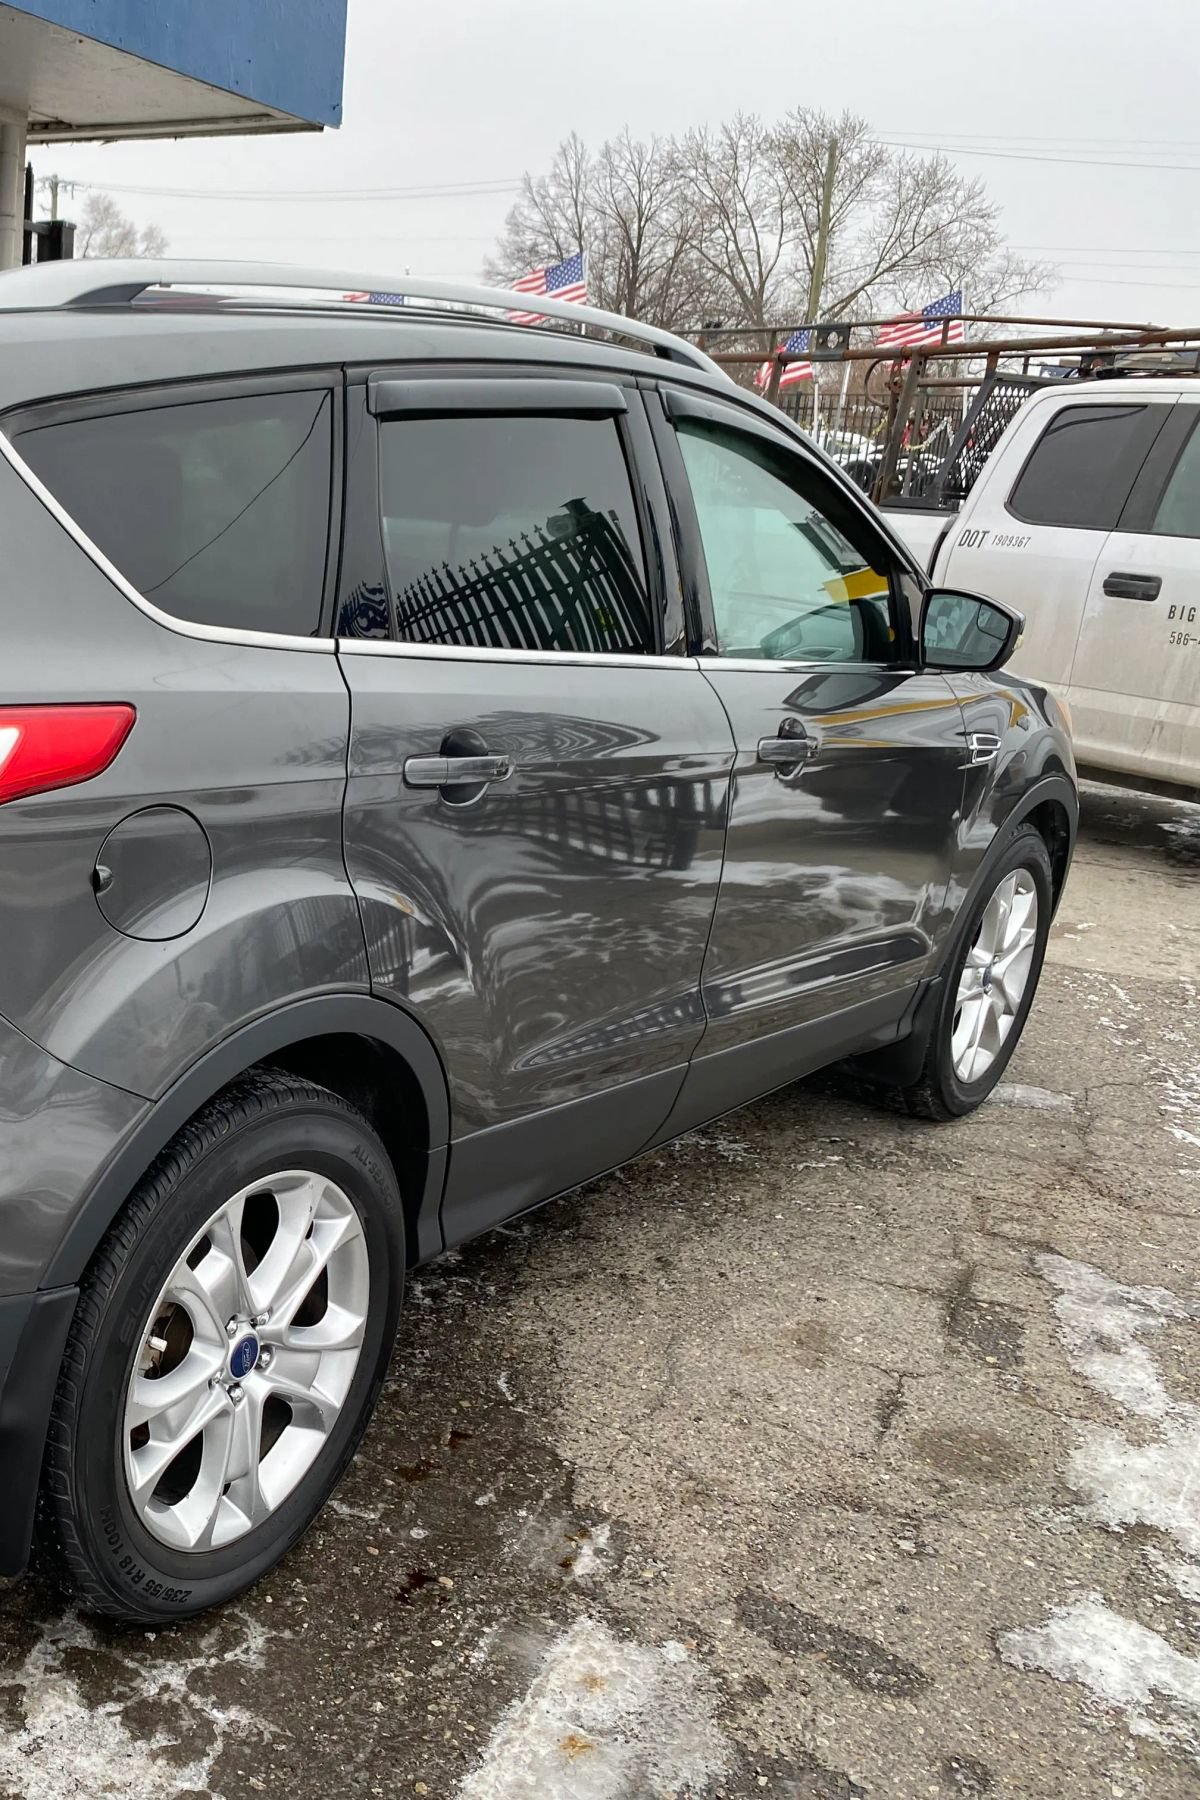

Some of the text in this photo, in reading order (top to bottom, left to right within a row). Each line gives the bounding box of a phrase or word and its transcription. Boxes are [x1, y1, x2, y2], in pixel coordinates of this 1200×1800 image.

[958, 529, 1031, 549] DOT 1909367
[1168, 605, 1196, 622] BIG
[1170, 631, 1200, 646] 586-
[119, 1555, 145, 1585] R18
[142, 1579, 193, 1603] 235/55
